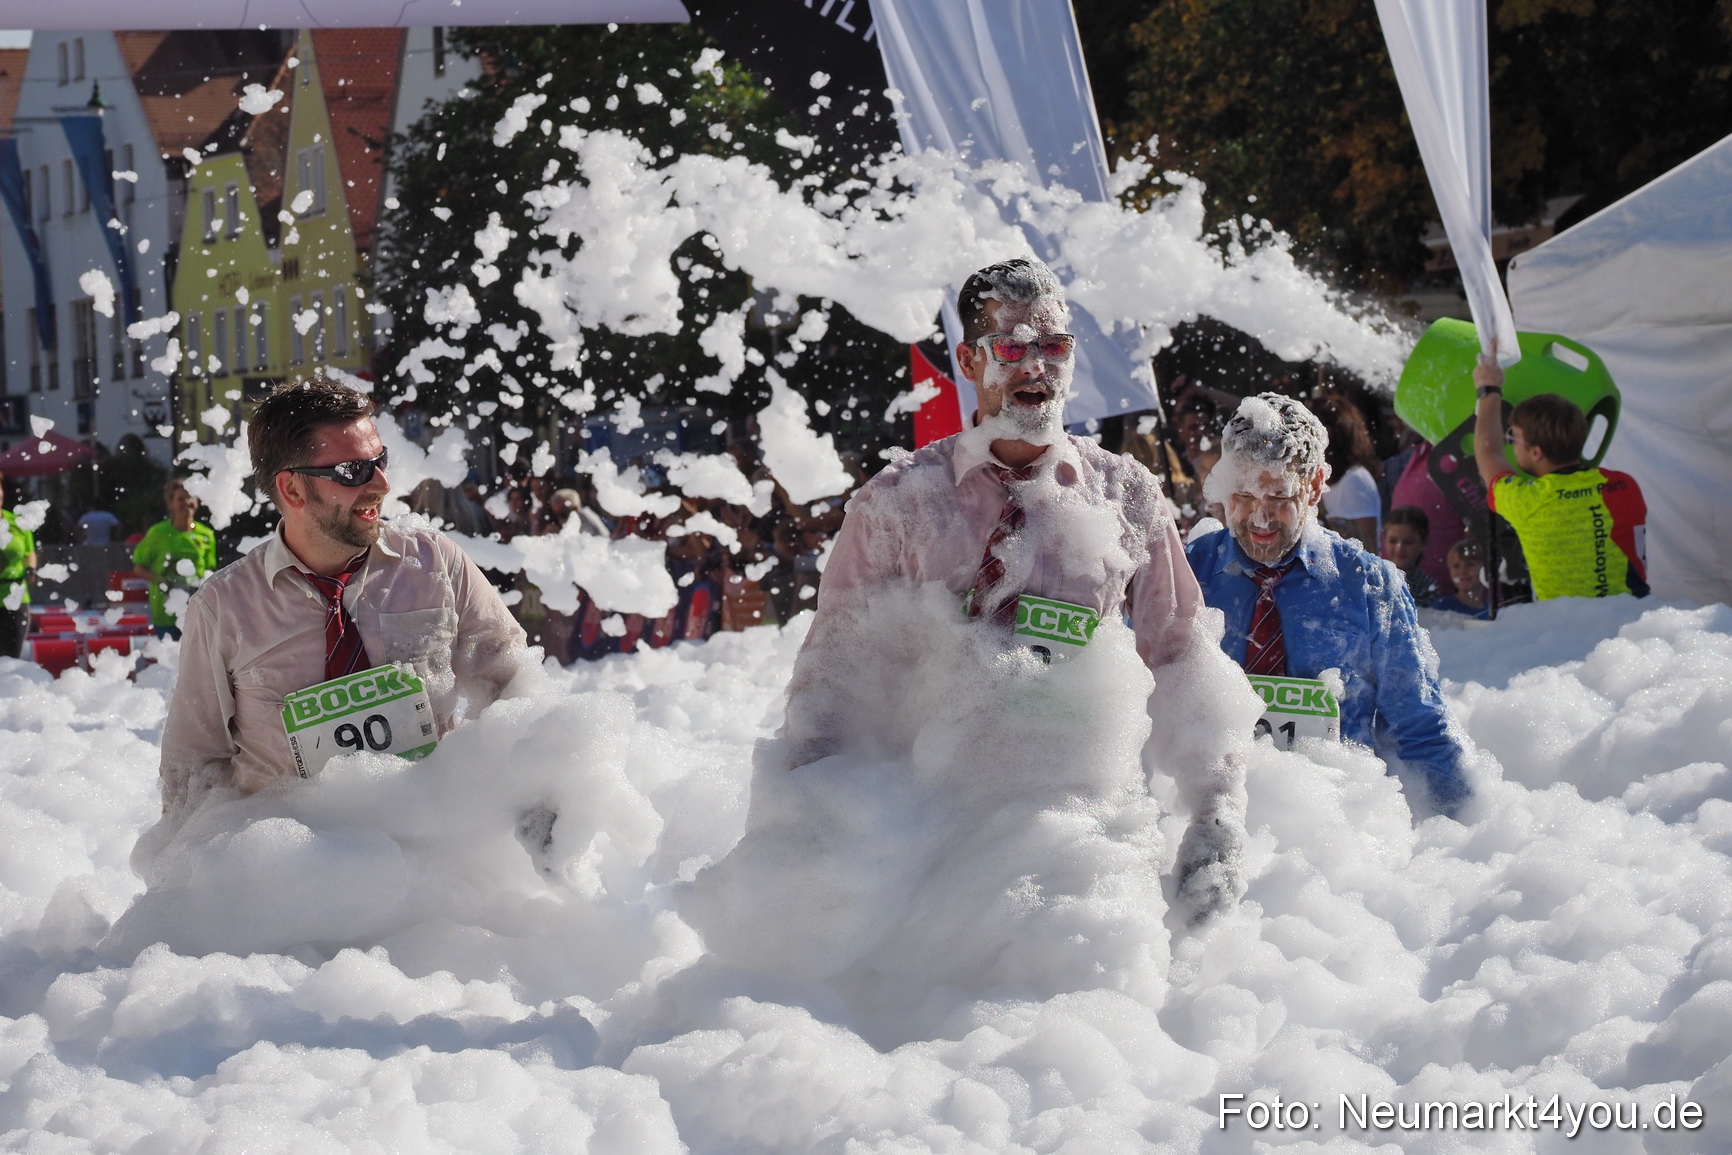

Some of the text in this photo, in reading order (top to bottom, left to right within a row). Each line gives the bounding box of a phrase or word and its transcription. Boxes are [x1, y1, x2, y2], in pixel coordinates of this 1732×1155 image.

[1556, 488, 1592, 499] Team
[1588, 504, 1609, 598] Motorsport
[291, 670, 405, 722] BOCK
[1253, 684, 1326, 709] OCK
[334, 714, 393, 751] 90
